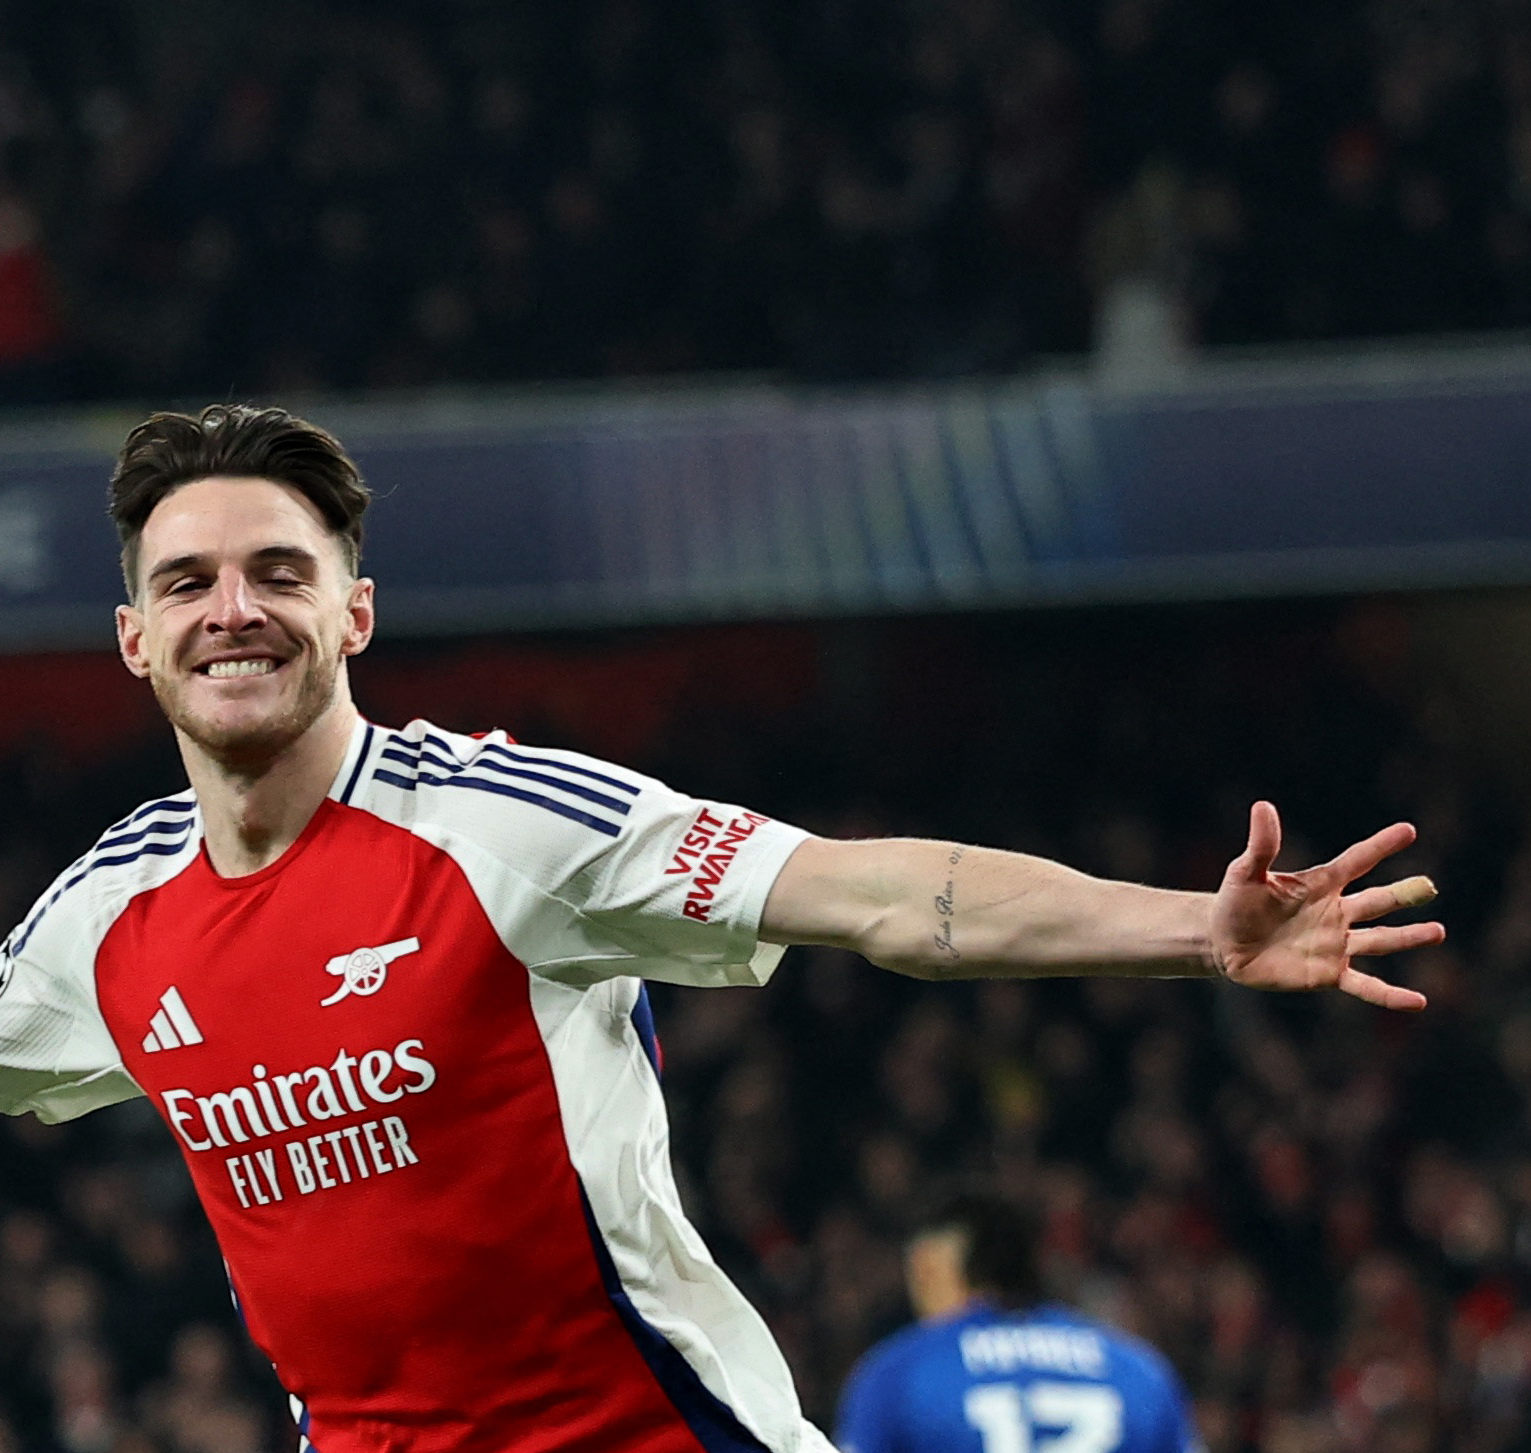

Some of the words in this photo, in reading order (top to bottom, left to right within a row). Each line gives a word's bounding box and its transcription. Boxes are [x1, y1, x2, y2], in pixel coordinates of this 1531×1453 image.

[663, 807, 725, 875] VISIT
[160, 1039, 437, 1152] Emirates
[225, 1148, 284, 1209] FLY
[285, 1116, 420, 1195] BETTER
